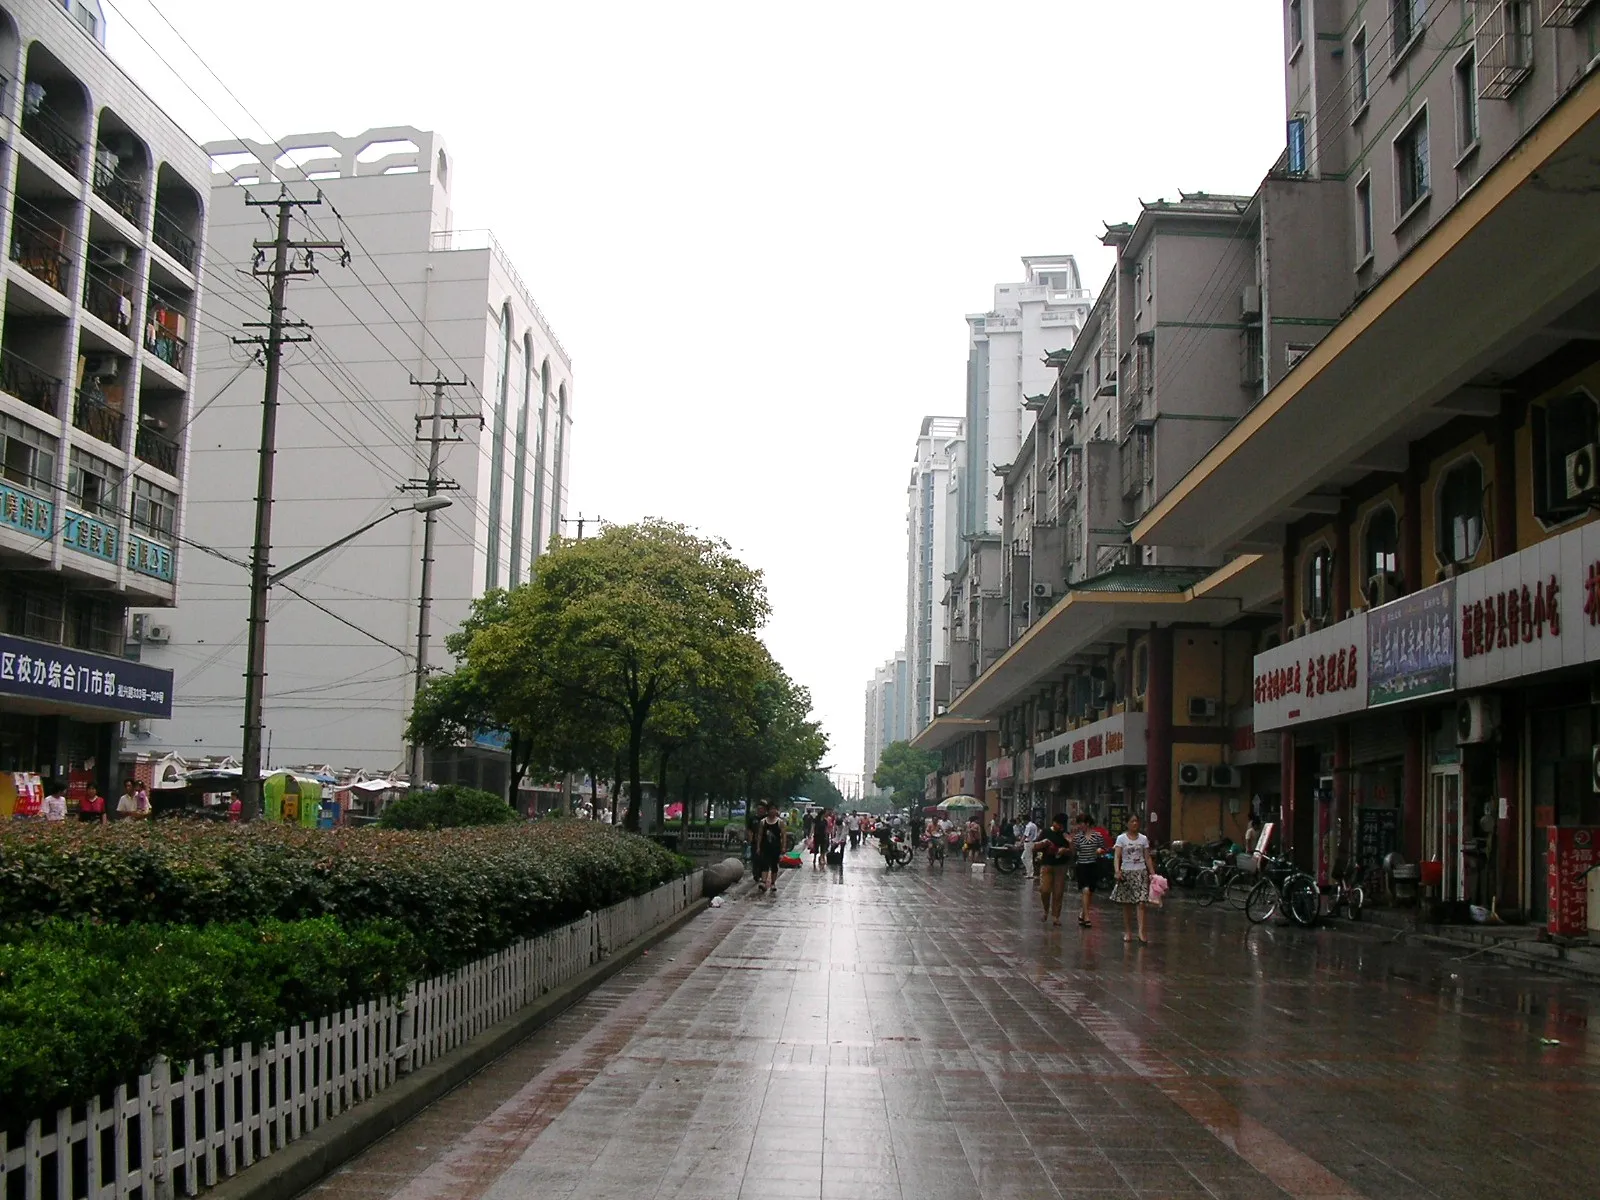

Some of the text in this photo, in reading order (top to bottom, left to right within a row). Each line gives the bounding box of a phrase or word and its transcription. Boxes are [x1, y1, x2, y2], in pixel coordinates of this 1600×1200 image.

[1461, 574, 1560, 659] 福建沙县特色小吃
[1, 652, 116, 697] 区校办综合门市部
